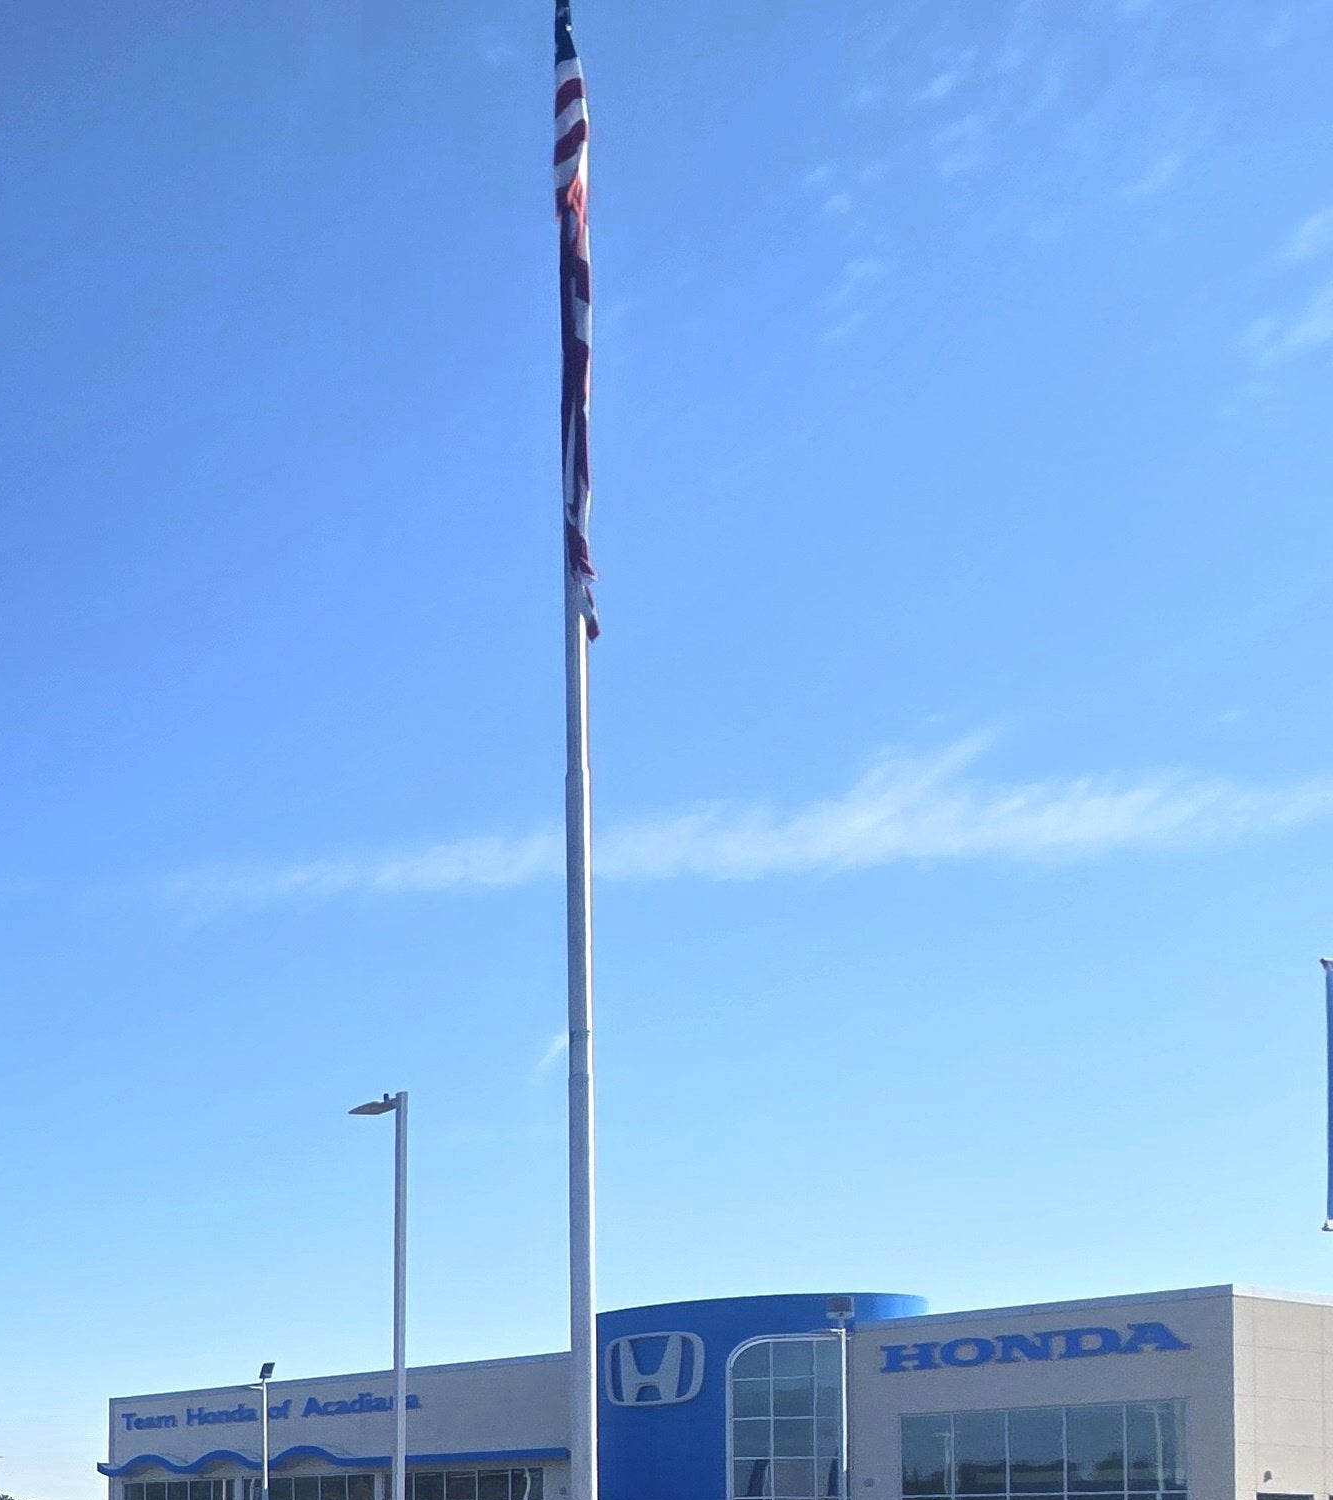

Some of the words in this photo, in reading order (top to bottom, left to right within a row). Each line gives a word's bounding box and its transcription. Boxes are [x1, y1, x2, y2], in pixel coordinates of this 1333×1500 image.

[879, 1322, 1192, 1374] HONDA
[121, 1412, 177, 1431] Team
[186, 1403, 259, 1427] Honda
[267, 1398, 293, 1420] of
